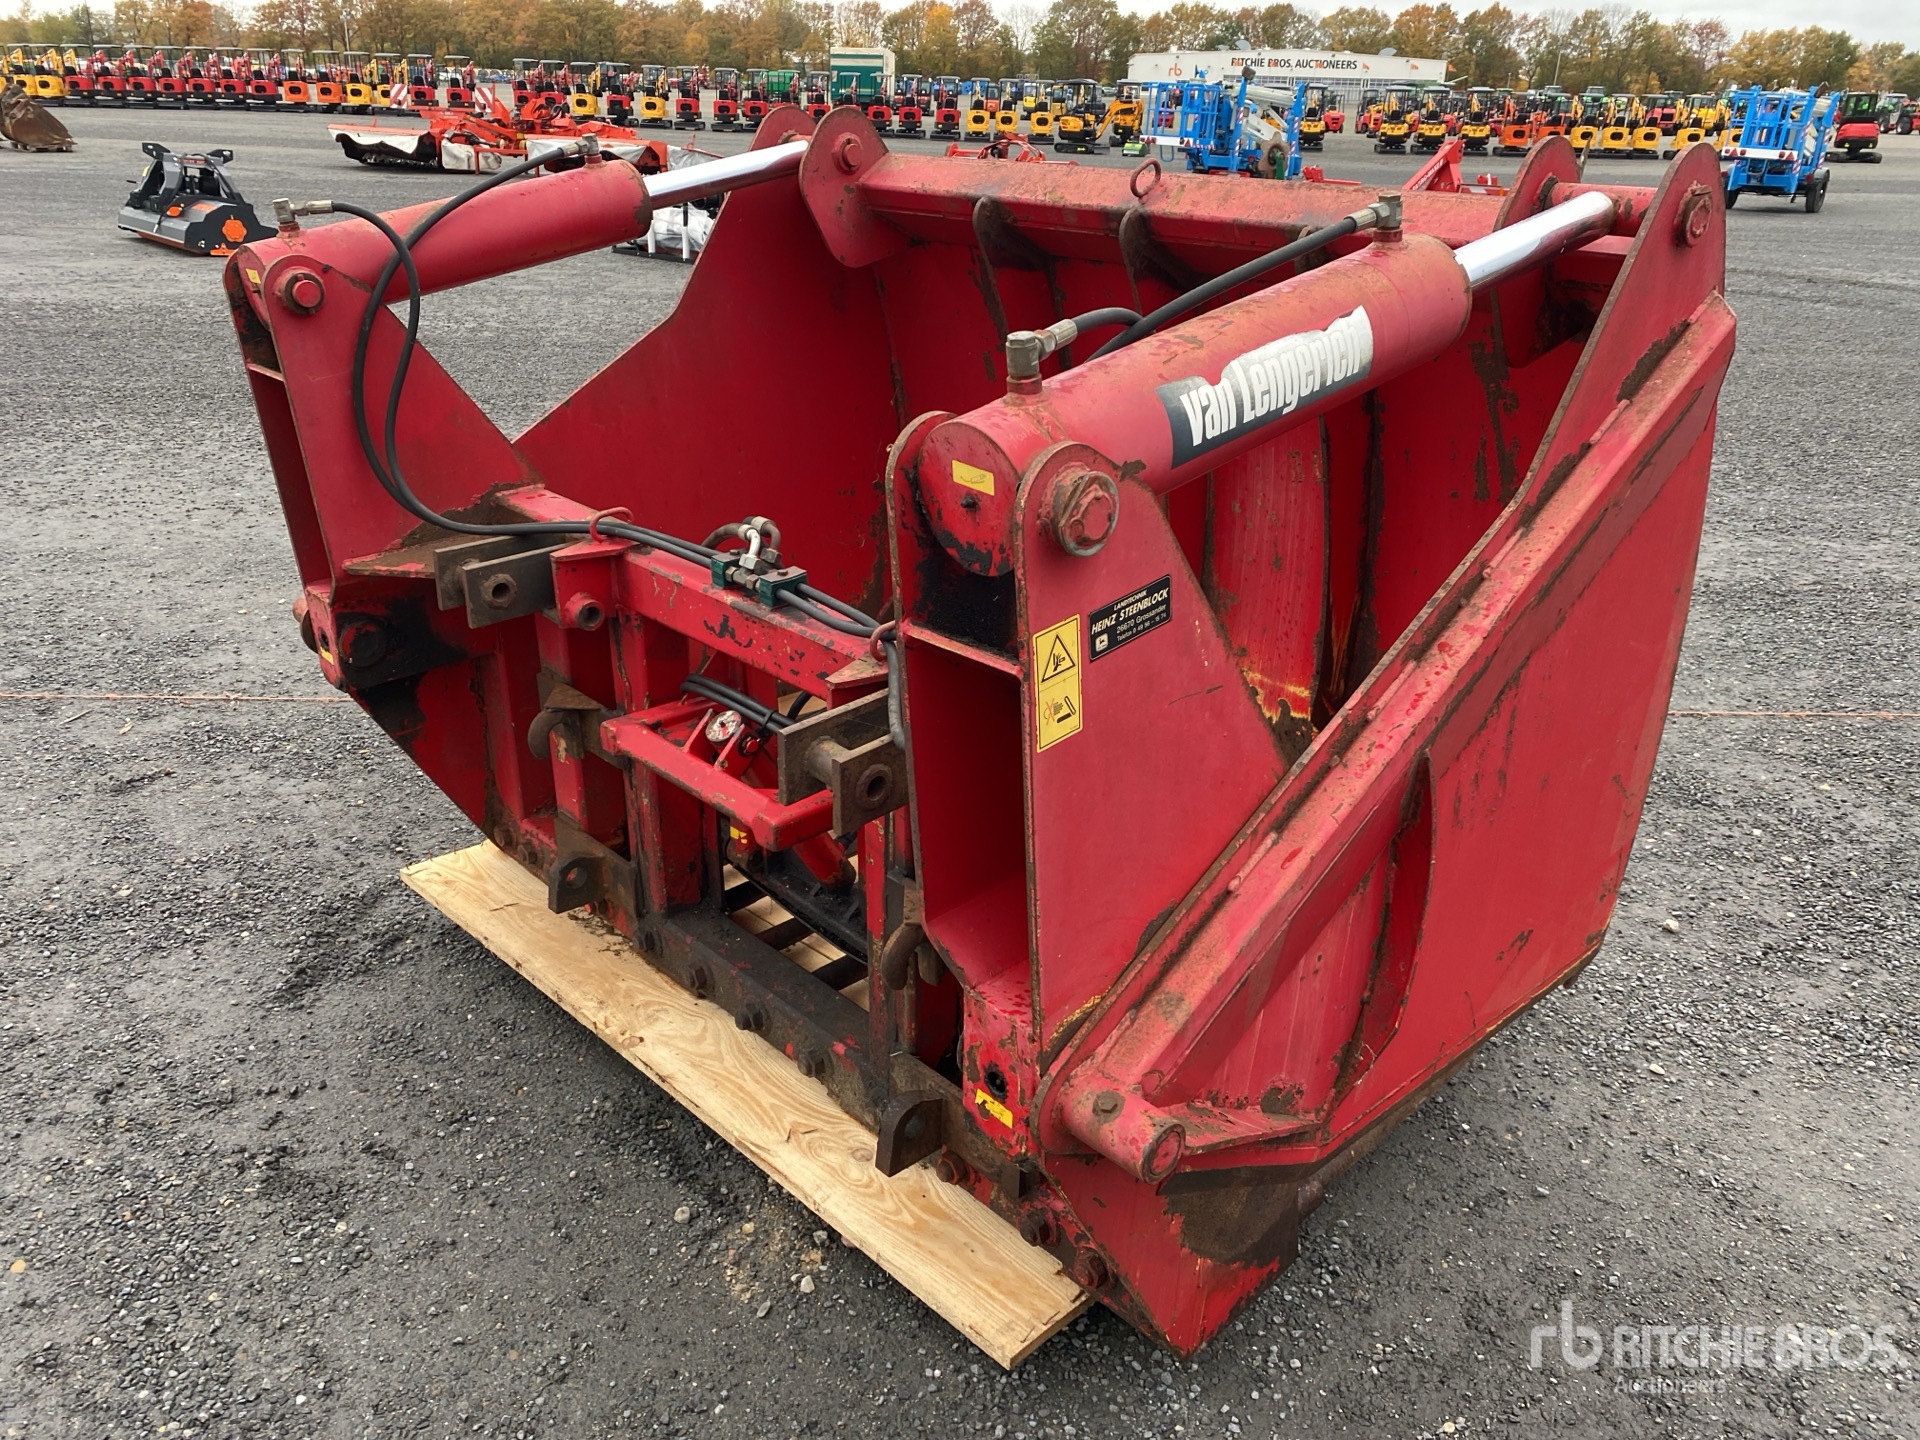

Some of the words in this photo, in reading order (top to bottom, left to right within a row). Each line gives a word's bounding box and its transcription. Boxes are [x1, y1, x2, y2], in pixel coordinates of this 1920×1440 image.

[1168, 63, 1182, 77] rb
[1231, 57, 1265, 67] RITCHIE
[1295, 58, 1358, 70] AUCTIONEERS
[1179, 377, 1237, 447] van
[1230, 325, 1361, 424] Lengerich
[1091, 613, 1118, 635] HEINZ
[1119, 587, 1169, 621] STEENBLOCK
